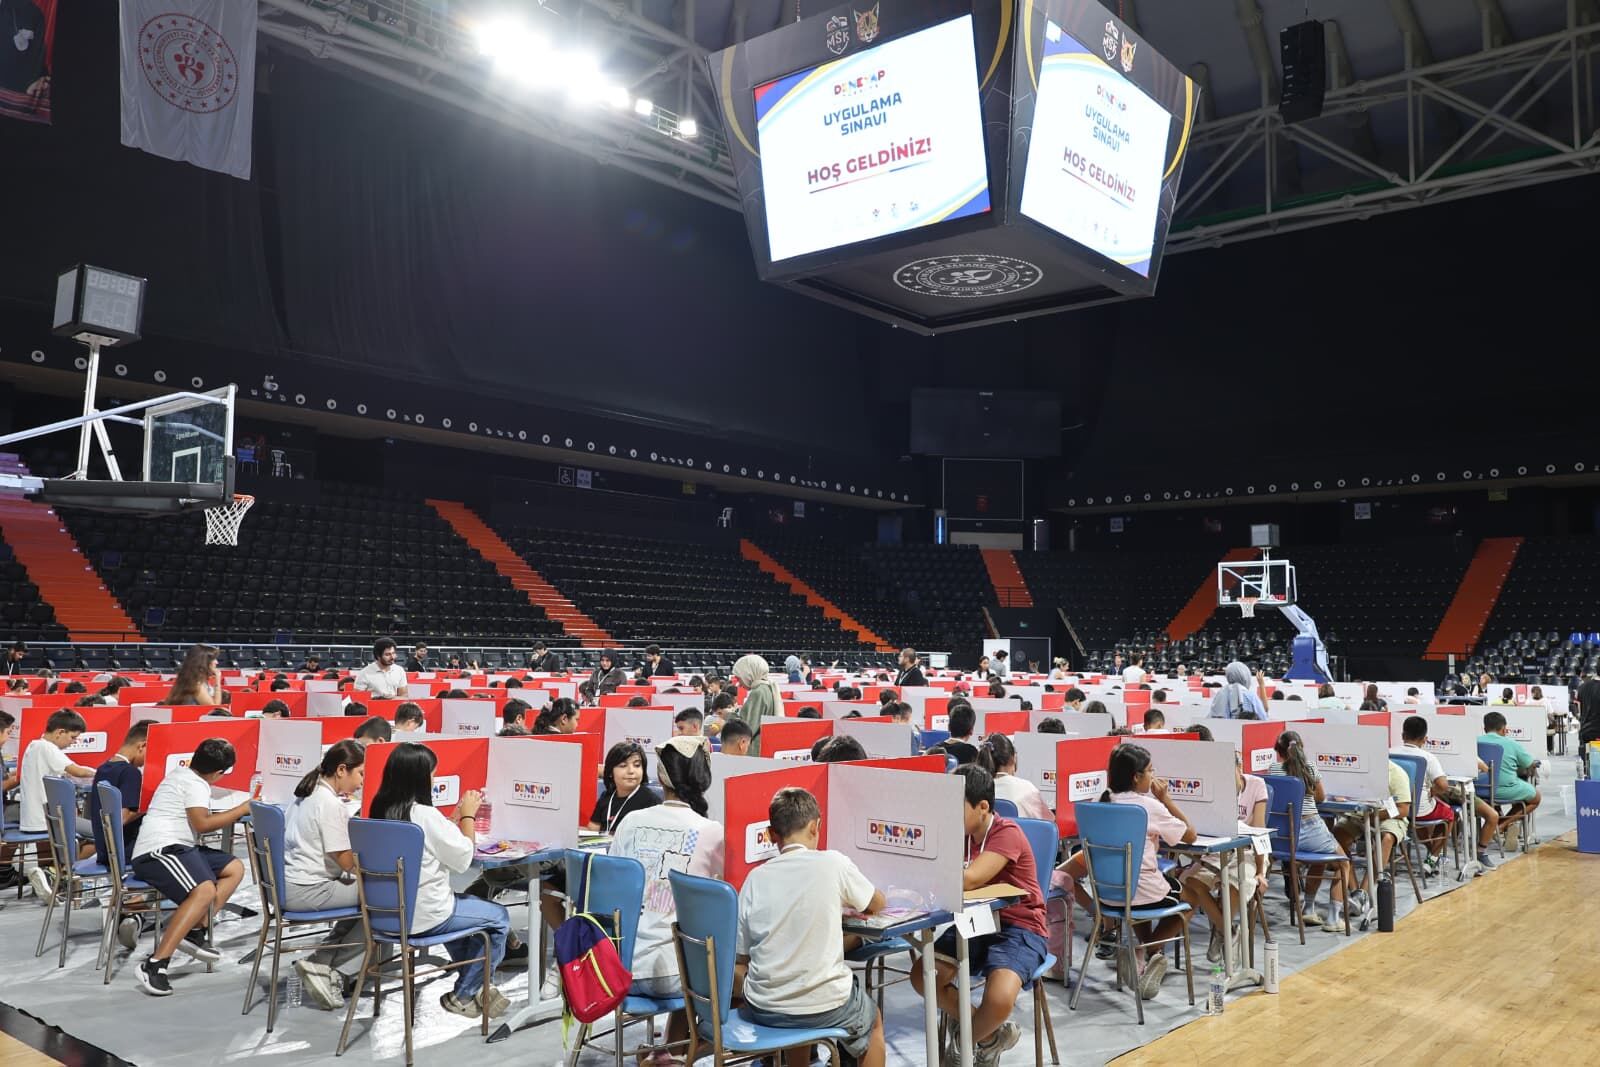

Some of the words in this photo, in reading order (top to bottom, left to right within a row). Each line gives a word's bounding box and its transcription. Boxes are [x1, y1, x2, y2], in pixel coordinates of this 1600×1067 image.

[827, 31, 850, 49] MSK
[823, 92, 903, 126] UYGULAMA
[840, 111, 887, 136] SINAVI
[1085, 103, 1131, 145] UYGULAMA
[1092, 126, 1121, 152] SINAVI
[807, 163, 842, 185] HOŞ
[846, 136, 932, 174] GELDİNİZ!
[1063, 146, 1086, 176] HOŞ
[1088, 163, 1136, 202] GELDİNİZ!
[1318, 754, 1358, 763] DENEYAP
[514, 783, 551, 795] DENEYAP
[1168, 779, 1201, 789] NEYAP
[870, 822, 922, 839] DENEYAP
[970, 916, 976, 933] 1
